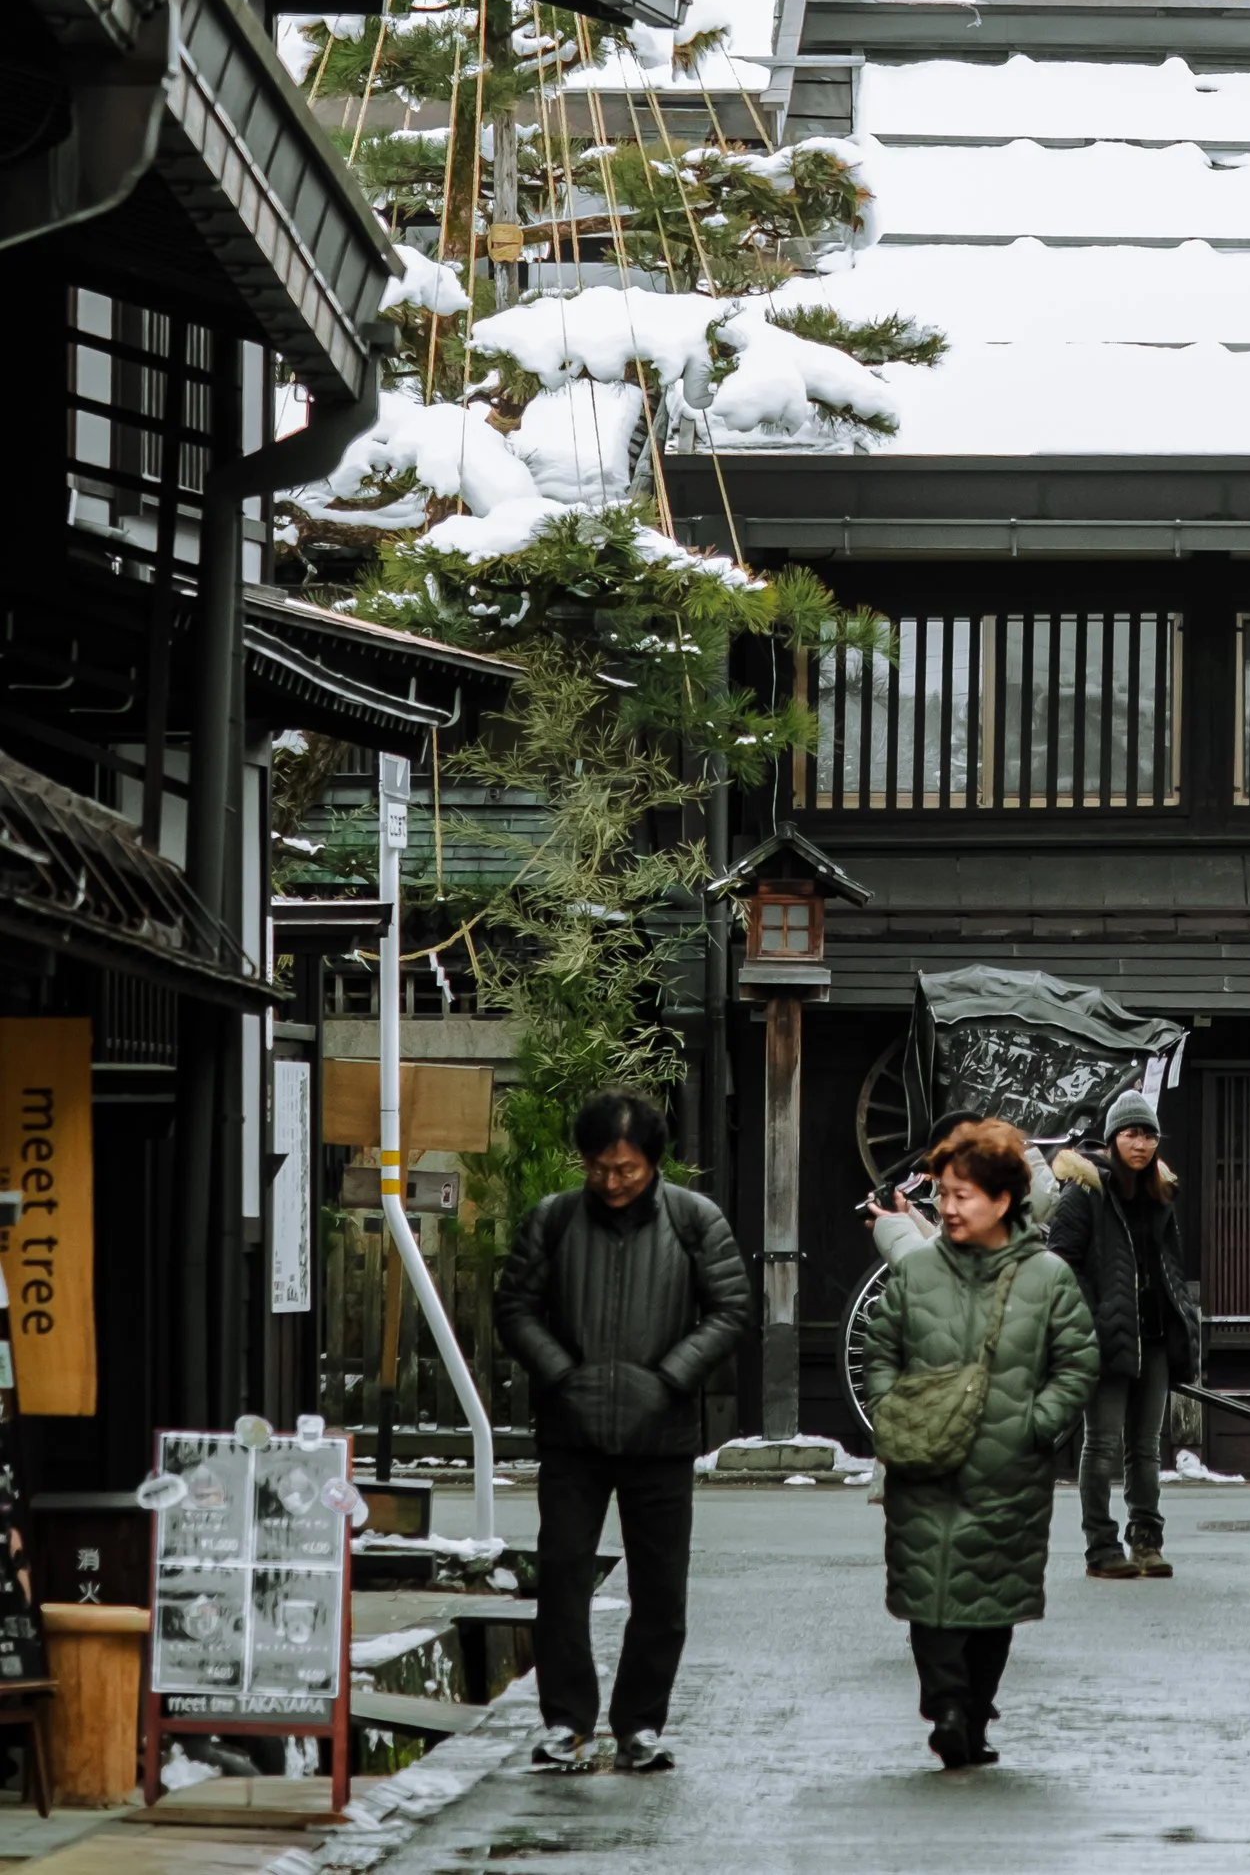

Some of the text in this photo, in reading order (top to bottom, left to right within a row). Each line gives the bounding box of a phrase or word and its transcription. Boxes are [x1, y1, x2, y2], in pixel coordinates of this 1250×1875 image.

[21, 1087, 58, 1336] meet tree
[167, 1696, 207, 1713] meet
[238, 1696, 326, 1714] TAKAYAMA
